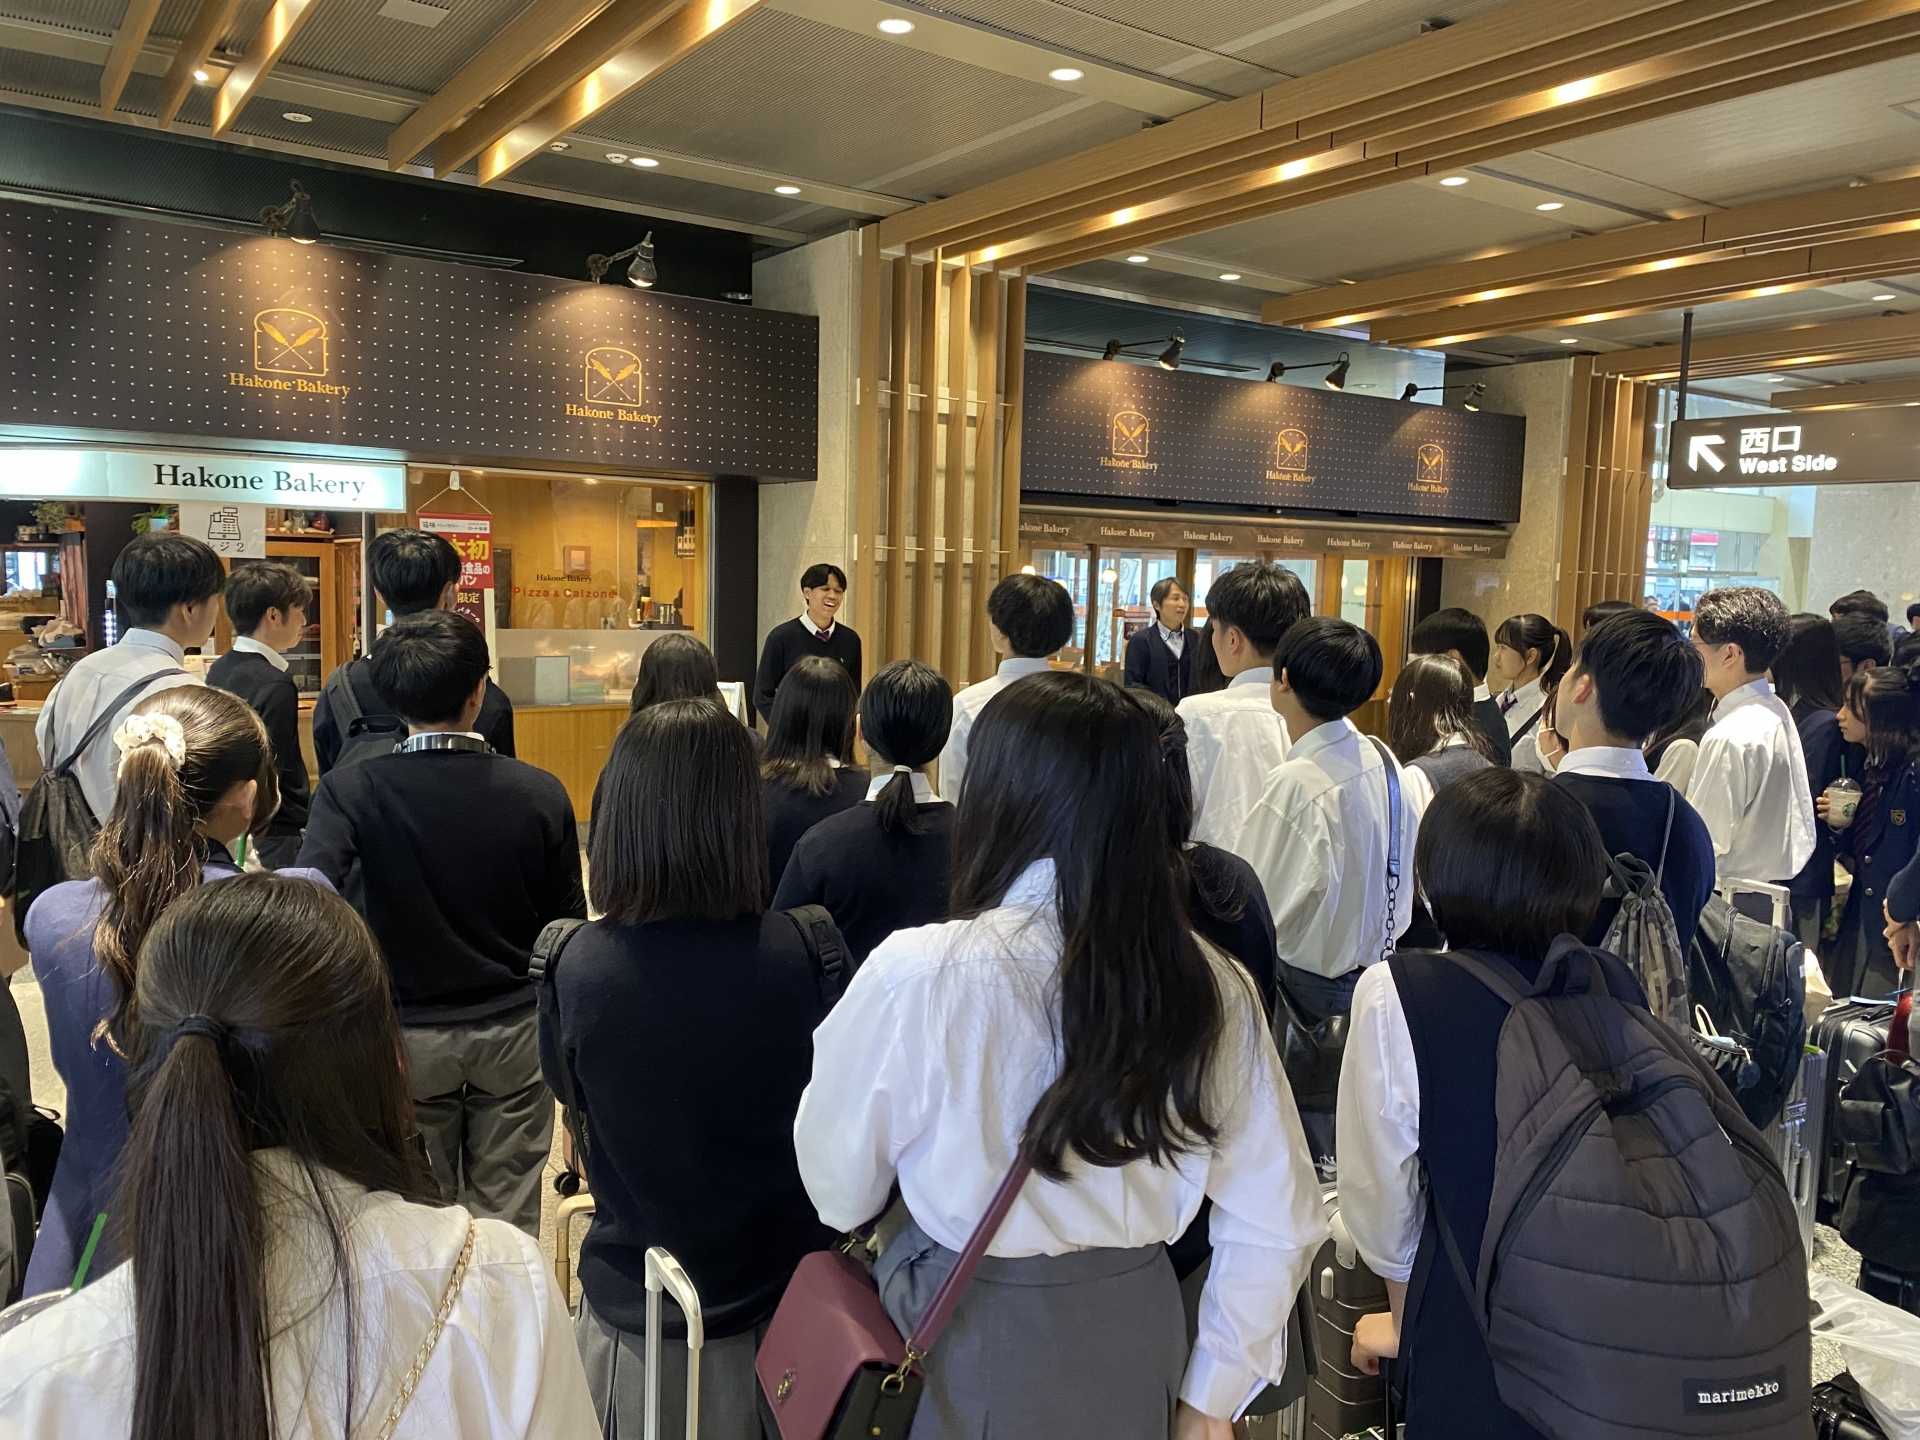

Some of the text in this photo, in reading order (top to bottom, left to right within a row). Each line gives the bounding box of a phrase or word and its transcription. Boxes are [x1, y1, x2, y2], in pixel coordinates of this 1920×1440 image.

[230, 372, 351, 398] Hakone Bakery
[565, 404, 662, 426] Hakone Bakery
[1740, 425, 1801, 455] 西口
[1100, 456, 1158, 473] Hakone Bakery
[1739, 454, 1838, 474] West Side
[153, 463, 365, 501] Hakone Bakery
[1265, 470, 1315, 485] Hakone Bakery
[1407, 481, 1449, 496] Hakone Bakery
[1019, 522, 1071, 536] akone Bakery
[1100, 526, 1155, 540] Hakone Bakery
[1183, 530, 1233, 544] Hakone Bakery
[1257, 535, 1304, 547] Hakone Bakery
[1327, 537, 1371, 549] Hakone Bakery
[1393, 540, 1433, 551] Hakone Bakery
[1453, 543, 1491, 554] Hakone Bakery
[536, 574, 566, 582] Hakone
[512, 586, 550, 597] Pizza
[563, 588, 618, 598] Calzone
[1698, 1382, 1780, 1404] marimekko
